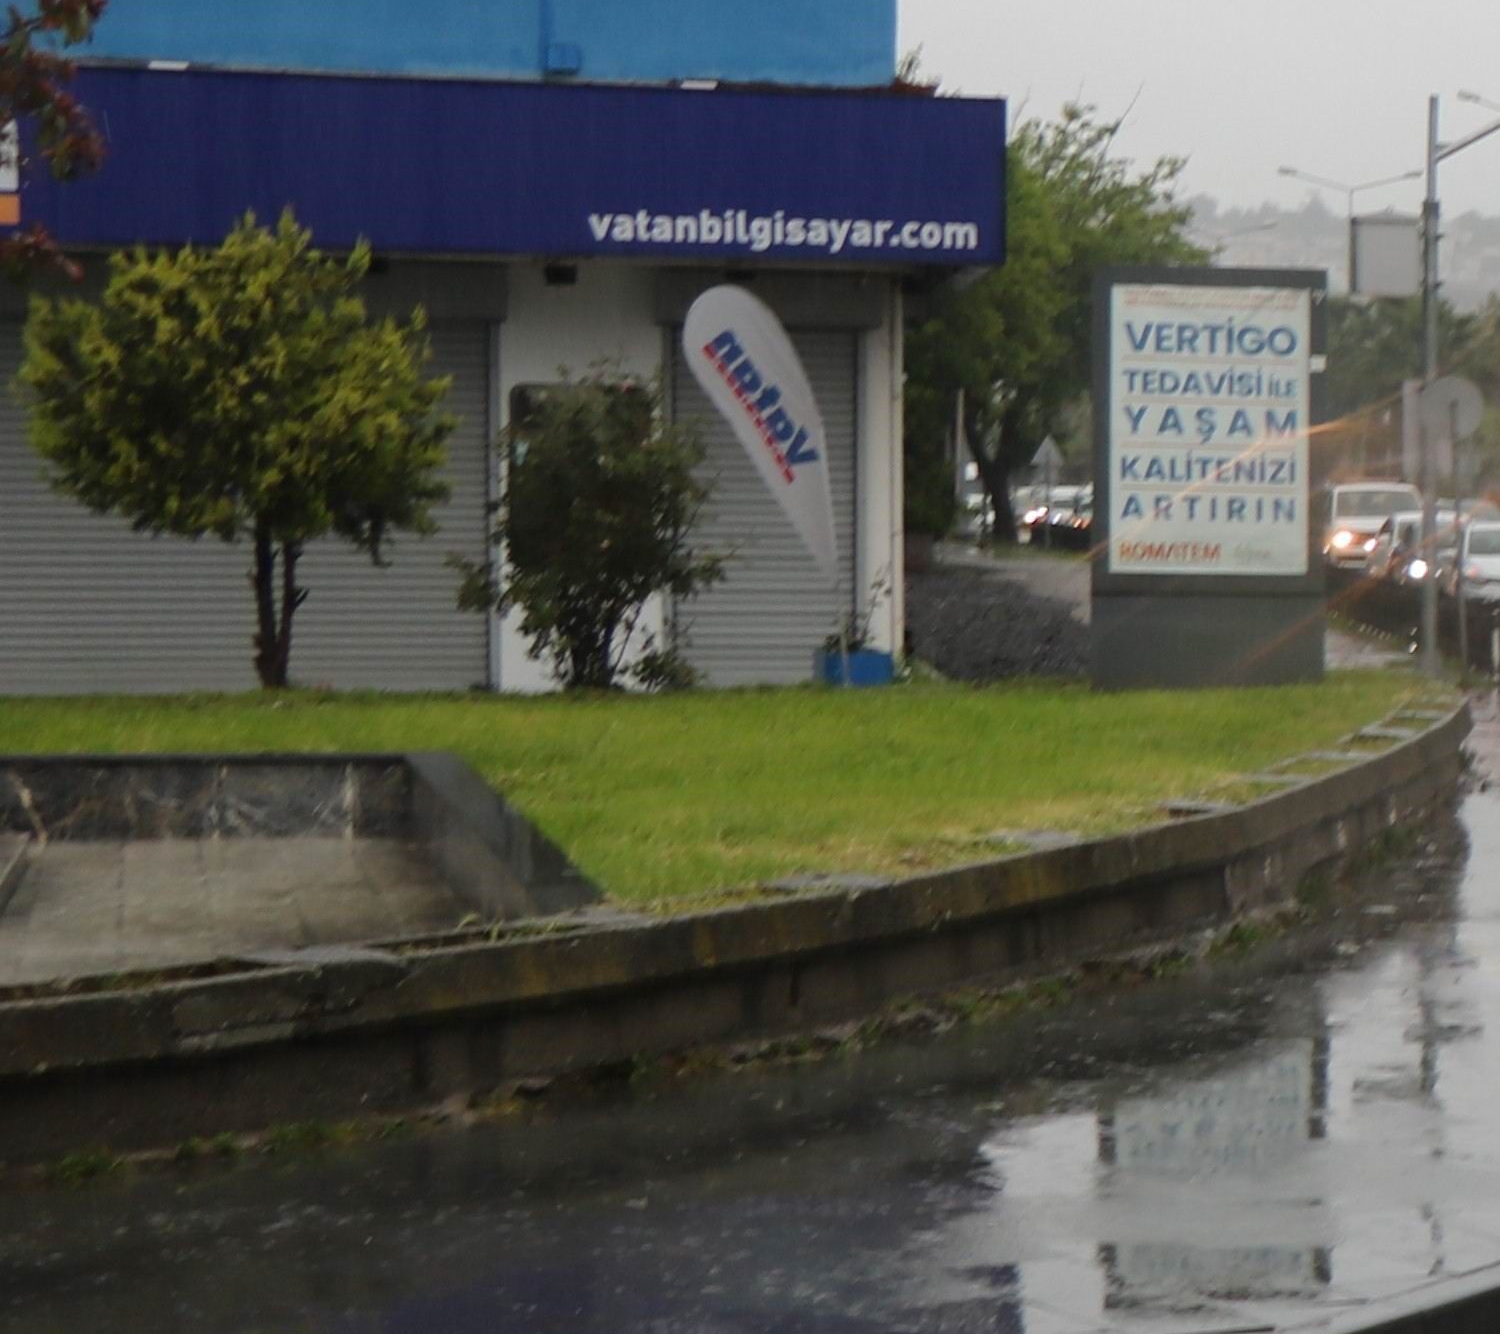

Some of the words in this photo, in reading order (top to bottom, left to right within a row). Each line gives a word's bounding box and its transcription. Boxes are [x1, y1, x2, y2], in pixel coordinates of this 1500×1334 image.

[587, 209, 979, 254] vatanbilgisayar.com
[1125, 318, 1298, 355] VERTİGO
[1122, 367, 1264, 397] TEDAVİSİ
[1123, 404, 1299, 445] YAŞAM
[1119, 450, 1296, 484] KALİTENİZİ
[1119, 493, 1296, 522] ARTIRIN
